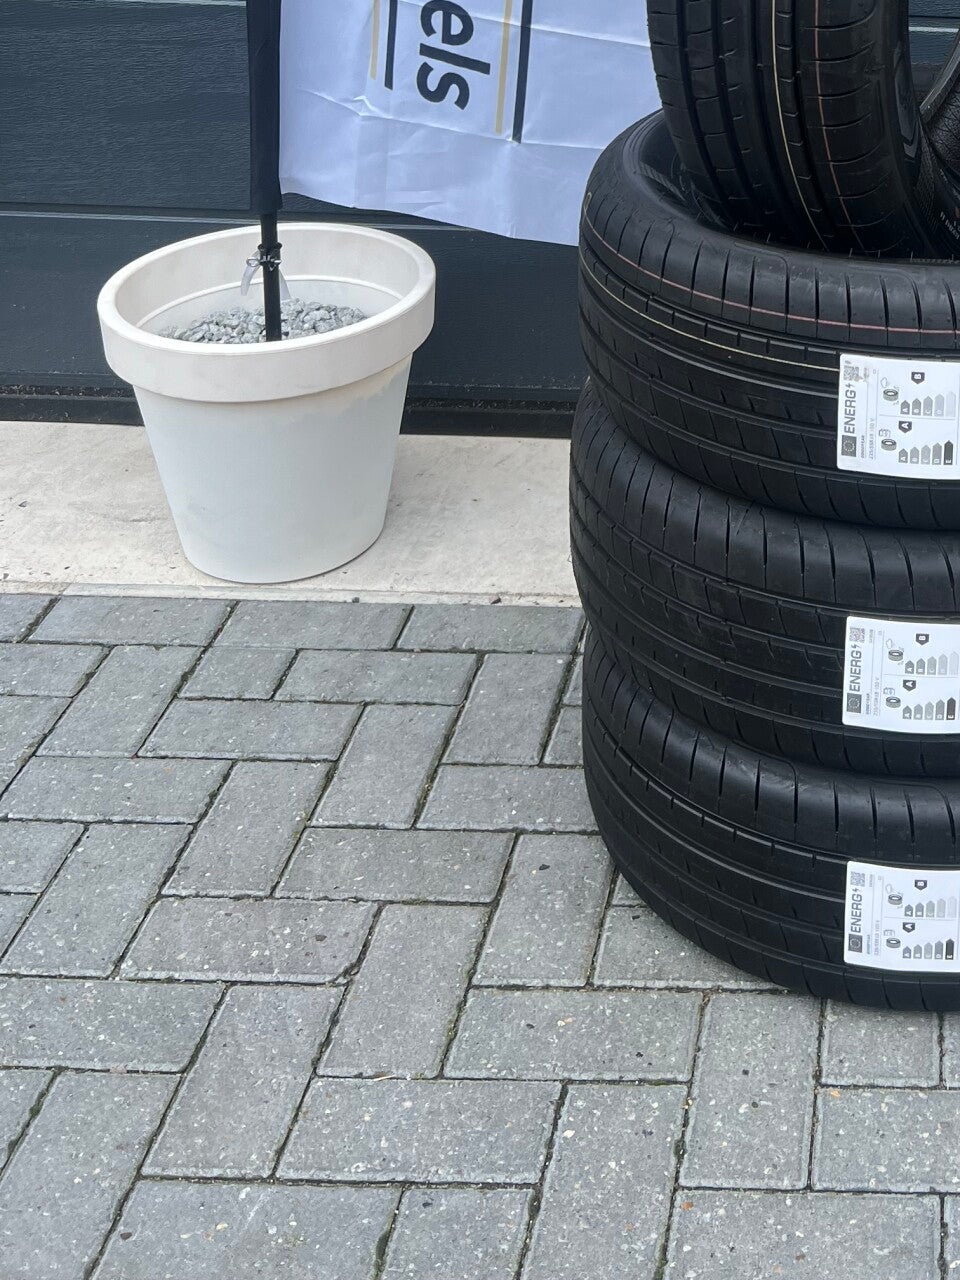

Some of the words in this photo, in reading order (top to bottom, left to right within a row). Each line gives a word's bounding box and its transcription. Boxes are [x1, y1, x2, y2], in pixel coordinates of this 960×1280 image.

[843, 390, 856, 434] ENERG
[849, 650, 862, 692] ENERG
[851, 894, 862, 933] ENERG
